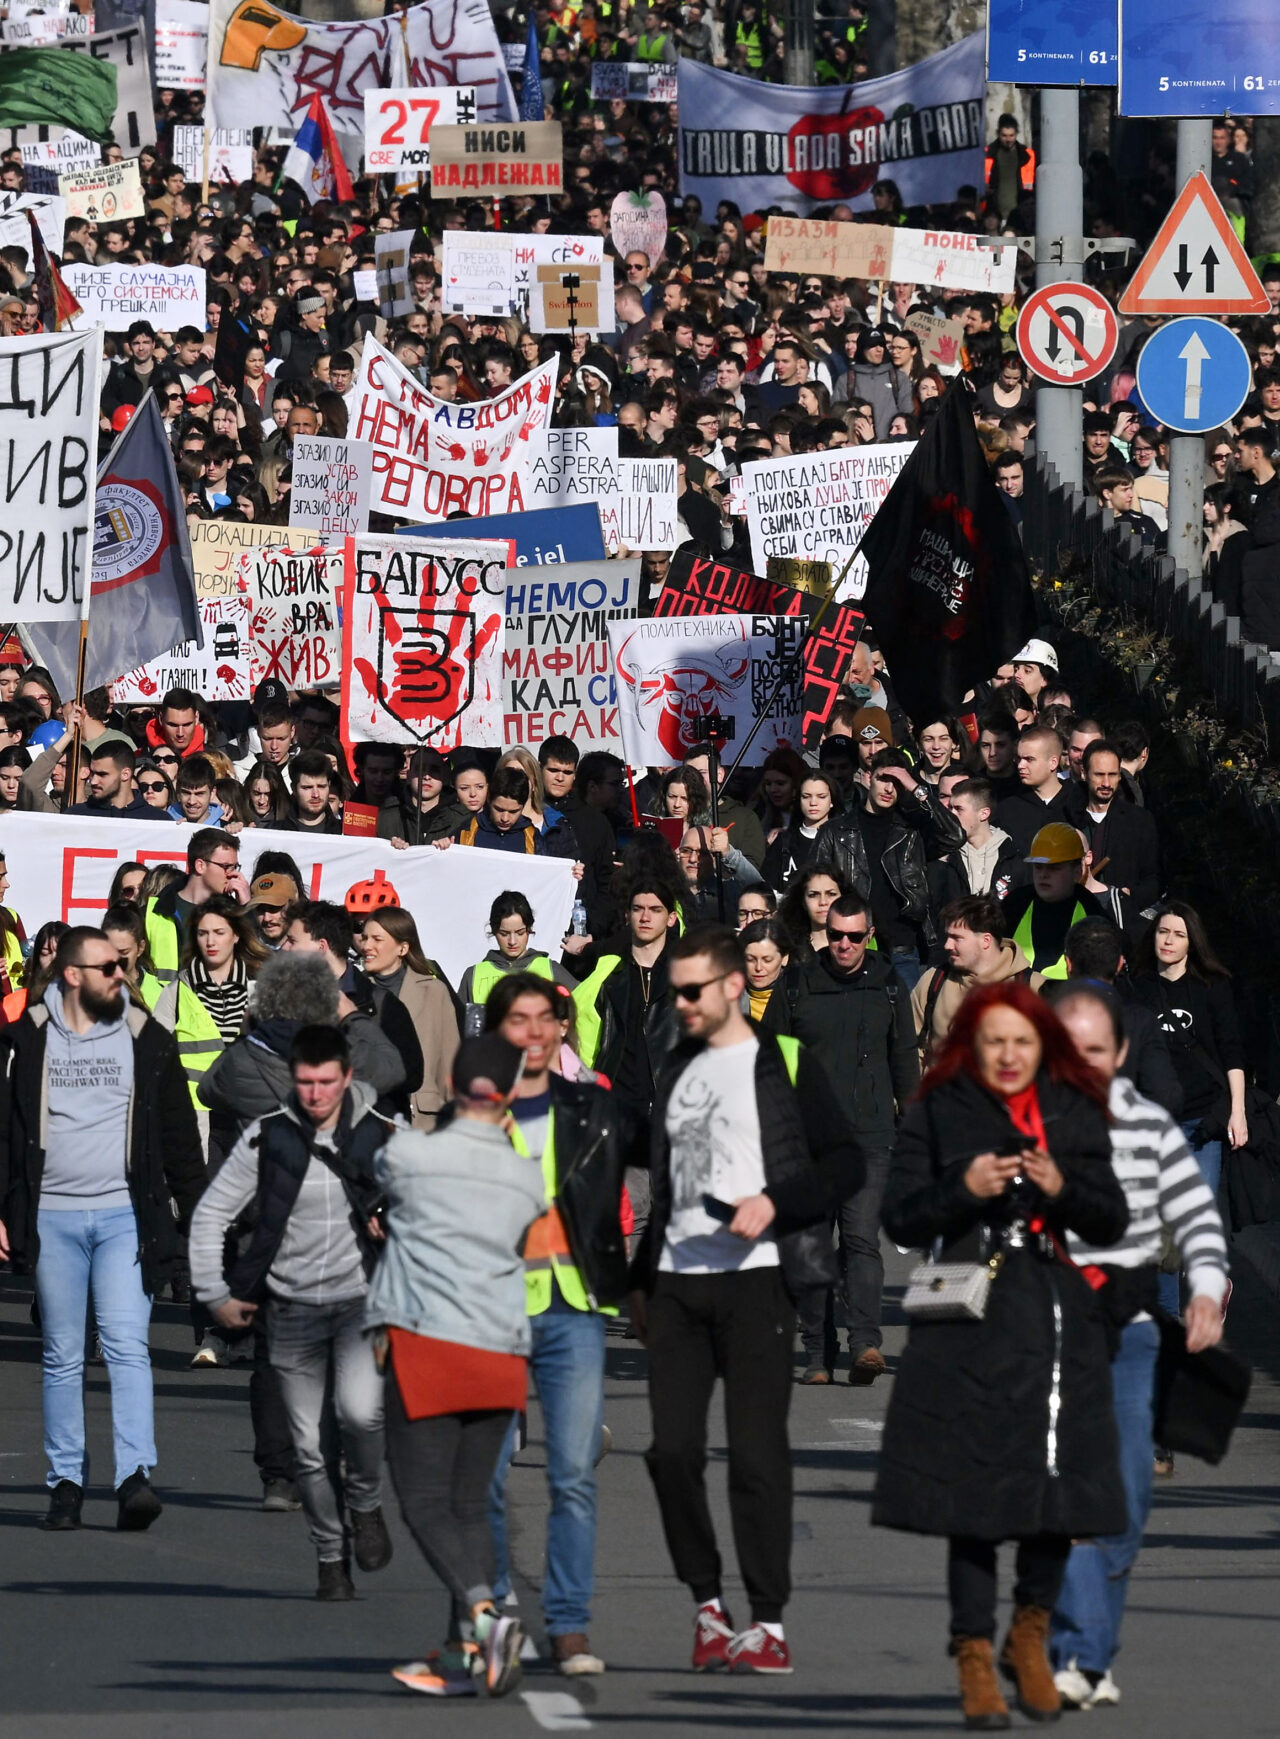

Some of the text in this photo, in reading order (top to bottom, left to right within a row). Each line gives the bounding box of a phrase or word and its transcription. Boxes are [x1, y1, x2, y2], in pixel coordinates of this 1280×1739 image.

[1017, 49, 1108, 64] 5 KONTINENATA 61
[1159, 76, 1265, 91] 5 KONTINENATA 61
[380, 99, 440, 145] 27
[465, 130, 526, 153] НИСИ
[684, 101, 982, 174] TRULA VLADA SAMA PADA
[23, 146, 40, 161] НА
[370, 151, 395, 165] СВЕ
[433, 162, 560, 189] НАДЛЕЖАН
[74, 272, 195, 287] НИЈЕ СЛУЧАЈНА
[113, 286, 199, 301] СИСТЕМСКА
[100, 299, 167, 313] ГРЕШКА!!!
[400, 377, 533, 431] ПРАВДОМ
[355, 393, 430, 463] НЕМА
[548, 432, 591, 452] PER
[297, 443, 349, 464] ЗГАЗИО СИ
[325, 463, 359, 480] УСТАВ
[532, 456, 614, 475] ASPERA
[830, 458, 866, 482] БАГРУ
[294, 474, 349, 491] ЗГАЗИО СИ
[534, 477, 618, 494] AD ASTRA
[324, 489, 358, 506] ЗАКОН
[757, 489, 812, 515] ЊИХОВА
[814, 482, 851, 508] ДУША
[852, 480, 864, 500] ЈЕ
[293, 499, 350, 518] ЗГАЗИО СИ
[319, 517, 359, 536] ДЕЦУ
[760, 511, 802, 536] СВИМА
[802, 510, 815, 529] СУ
[763, 534, 798, 558] СЕБИ
[256, 558, 344, 599] КОЛИК
[356, 549, 506, 597] БАПУСС
[505, 577, 630, 615] НЕМОЈ
[686, 557, 866, 646] КОЛИКА ЈЕ
[505, 616, 523, 631] ДА
[640, 620, 738, 640] ПОЛИТЕХНИКА
[751, 616, 809, 638] БУНТ
[765, 637, 797, 660] ЈЕ
[511, 676, 581, 712] КАД
[504, 706, 621, 744] ПЕСАК
[48, 1066, 123, 1077] PACIFIC COAST
[63, 1058, 94, 1067] CAMINO
[51, 1077, 120, 1088] HIGHWAY 101
